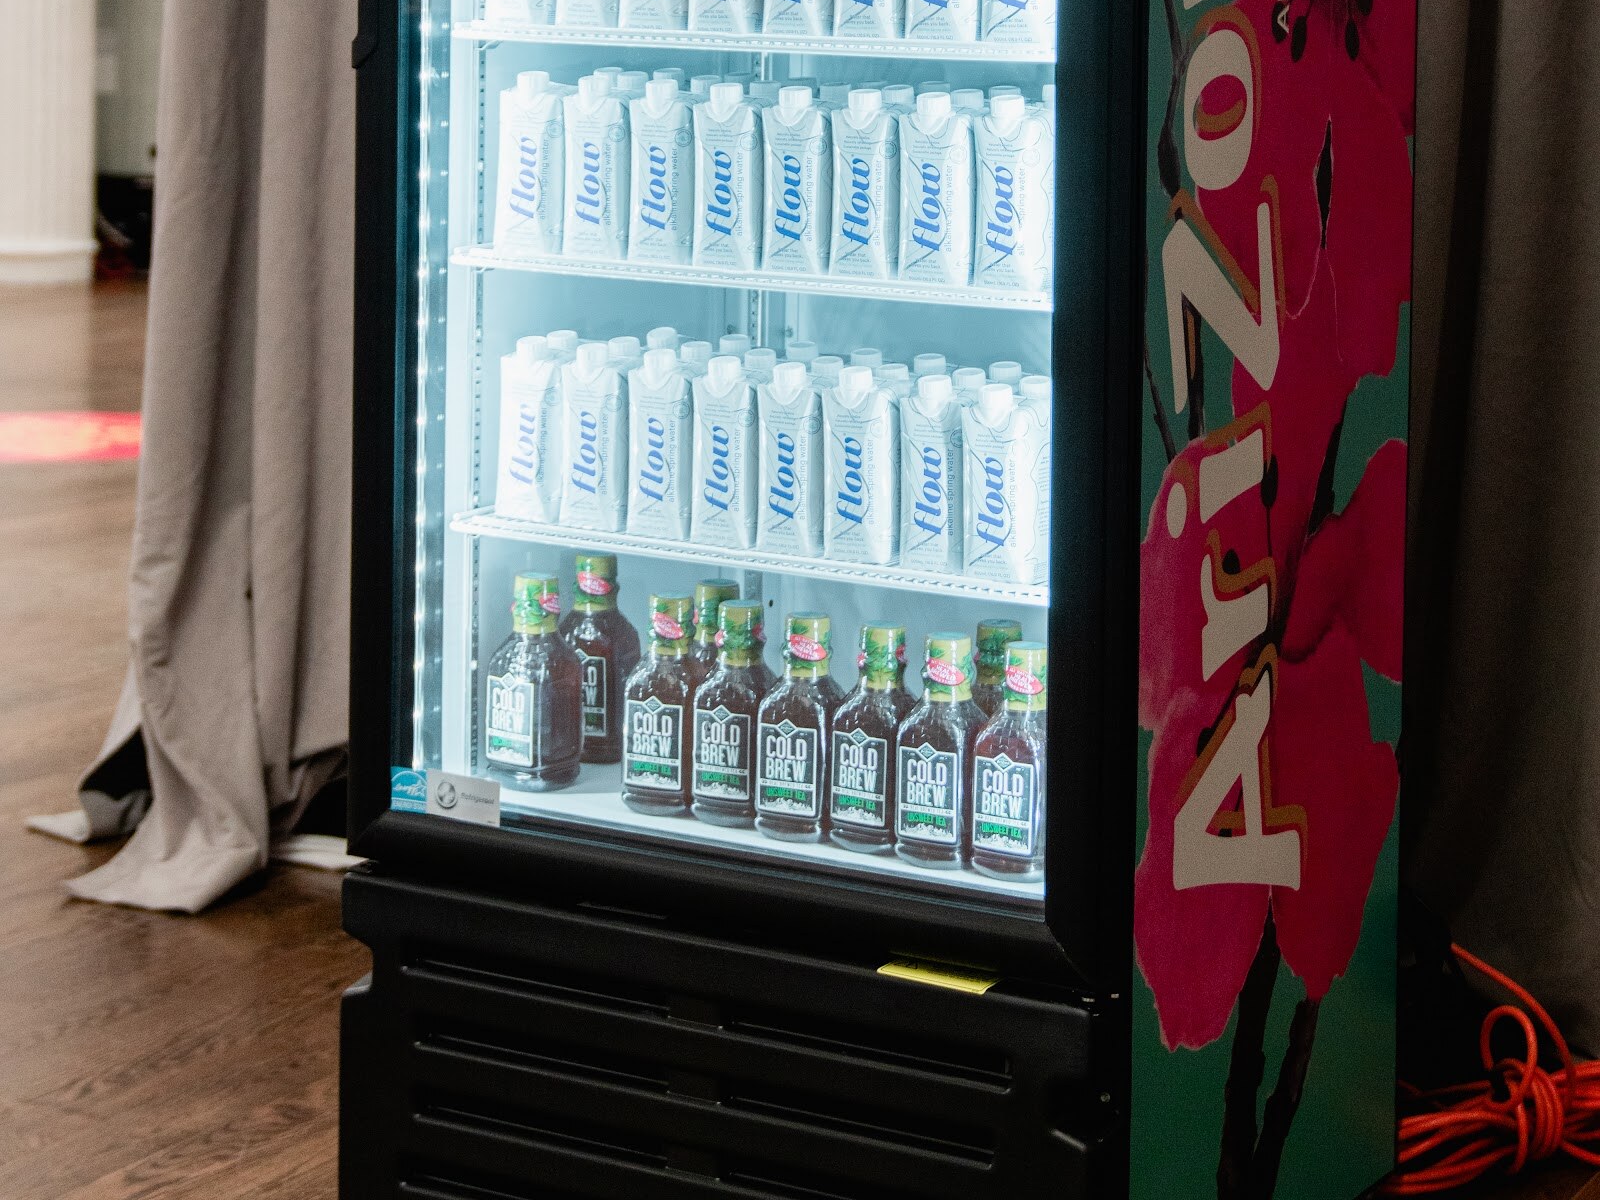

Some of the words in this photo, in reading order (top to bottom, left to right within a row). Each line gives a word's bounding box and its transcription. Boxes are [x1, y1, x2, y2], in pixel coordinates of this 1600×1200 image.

[511, 137, 536, 218] flow
[576, 143, 600, 224] flow
[642, 146, 666, 229] flow
[707, 150, 732, 235] flow
[776, 156, 800, 240] flow
[843, 159, 870, 244] flow
[912, 163, 940, 251] flow
[987, 166, 1013, 255] flow
[510, 404, 537, 486] flow
[571, 411, 597, 494] flow
[640, 418, 664, 500] flow
[705, 426, 729, 510] flow
[769, 433, 794, 519] flow
[838, 437, 862, 523] flow
[915, 448, 941, 534] flow
[977, 457, 1004, 546] flow
[492, 687, 525, 711] COLD
[633, 711, 672, 737] COLD
[701, 721, 740, 746] COLD
[632, 733, 672, 757] BREW
[700, 743, 740, 767] BREW
[766, 735, 807, 760] COLD
[840, 743, 878, 770] COLD
[660, 765, 672, 776] TEA
[729, 775, 740, 787] TEA
[766, 757, 806, 782] BREW
[839, 765, 877, 792] BREW
[907, 758, 947, 786] COLD
[982, 768, 1024, 797] COLD
[794, 790, 806, 801] TEA
[865, 800, 876, 811] TEA
[906, 781, 946, 808] BREW
[981, 791, 1022, 819] BREW
[935, 816, 946, 828] TEA
[1010, 826, 1022, 839] TEA
